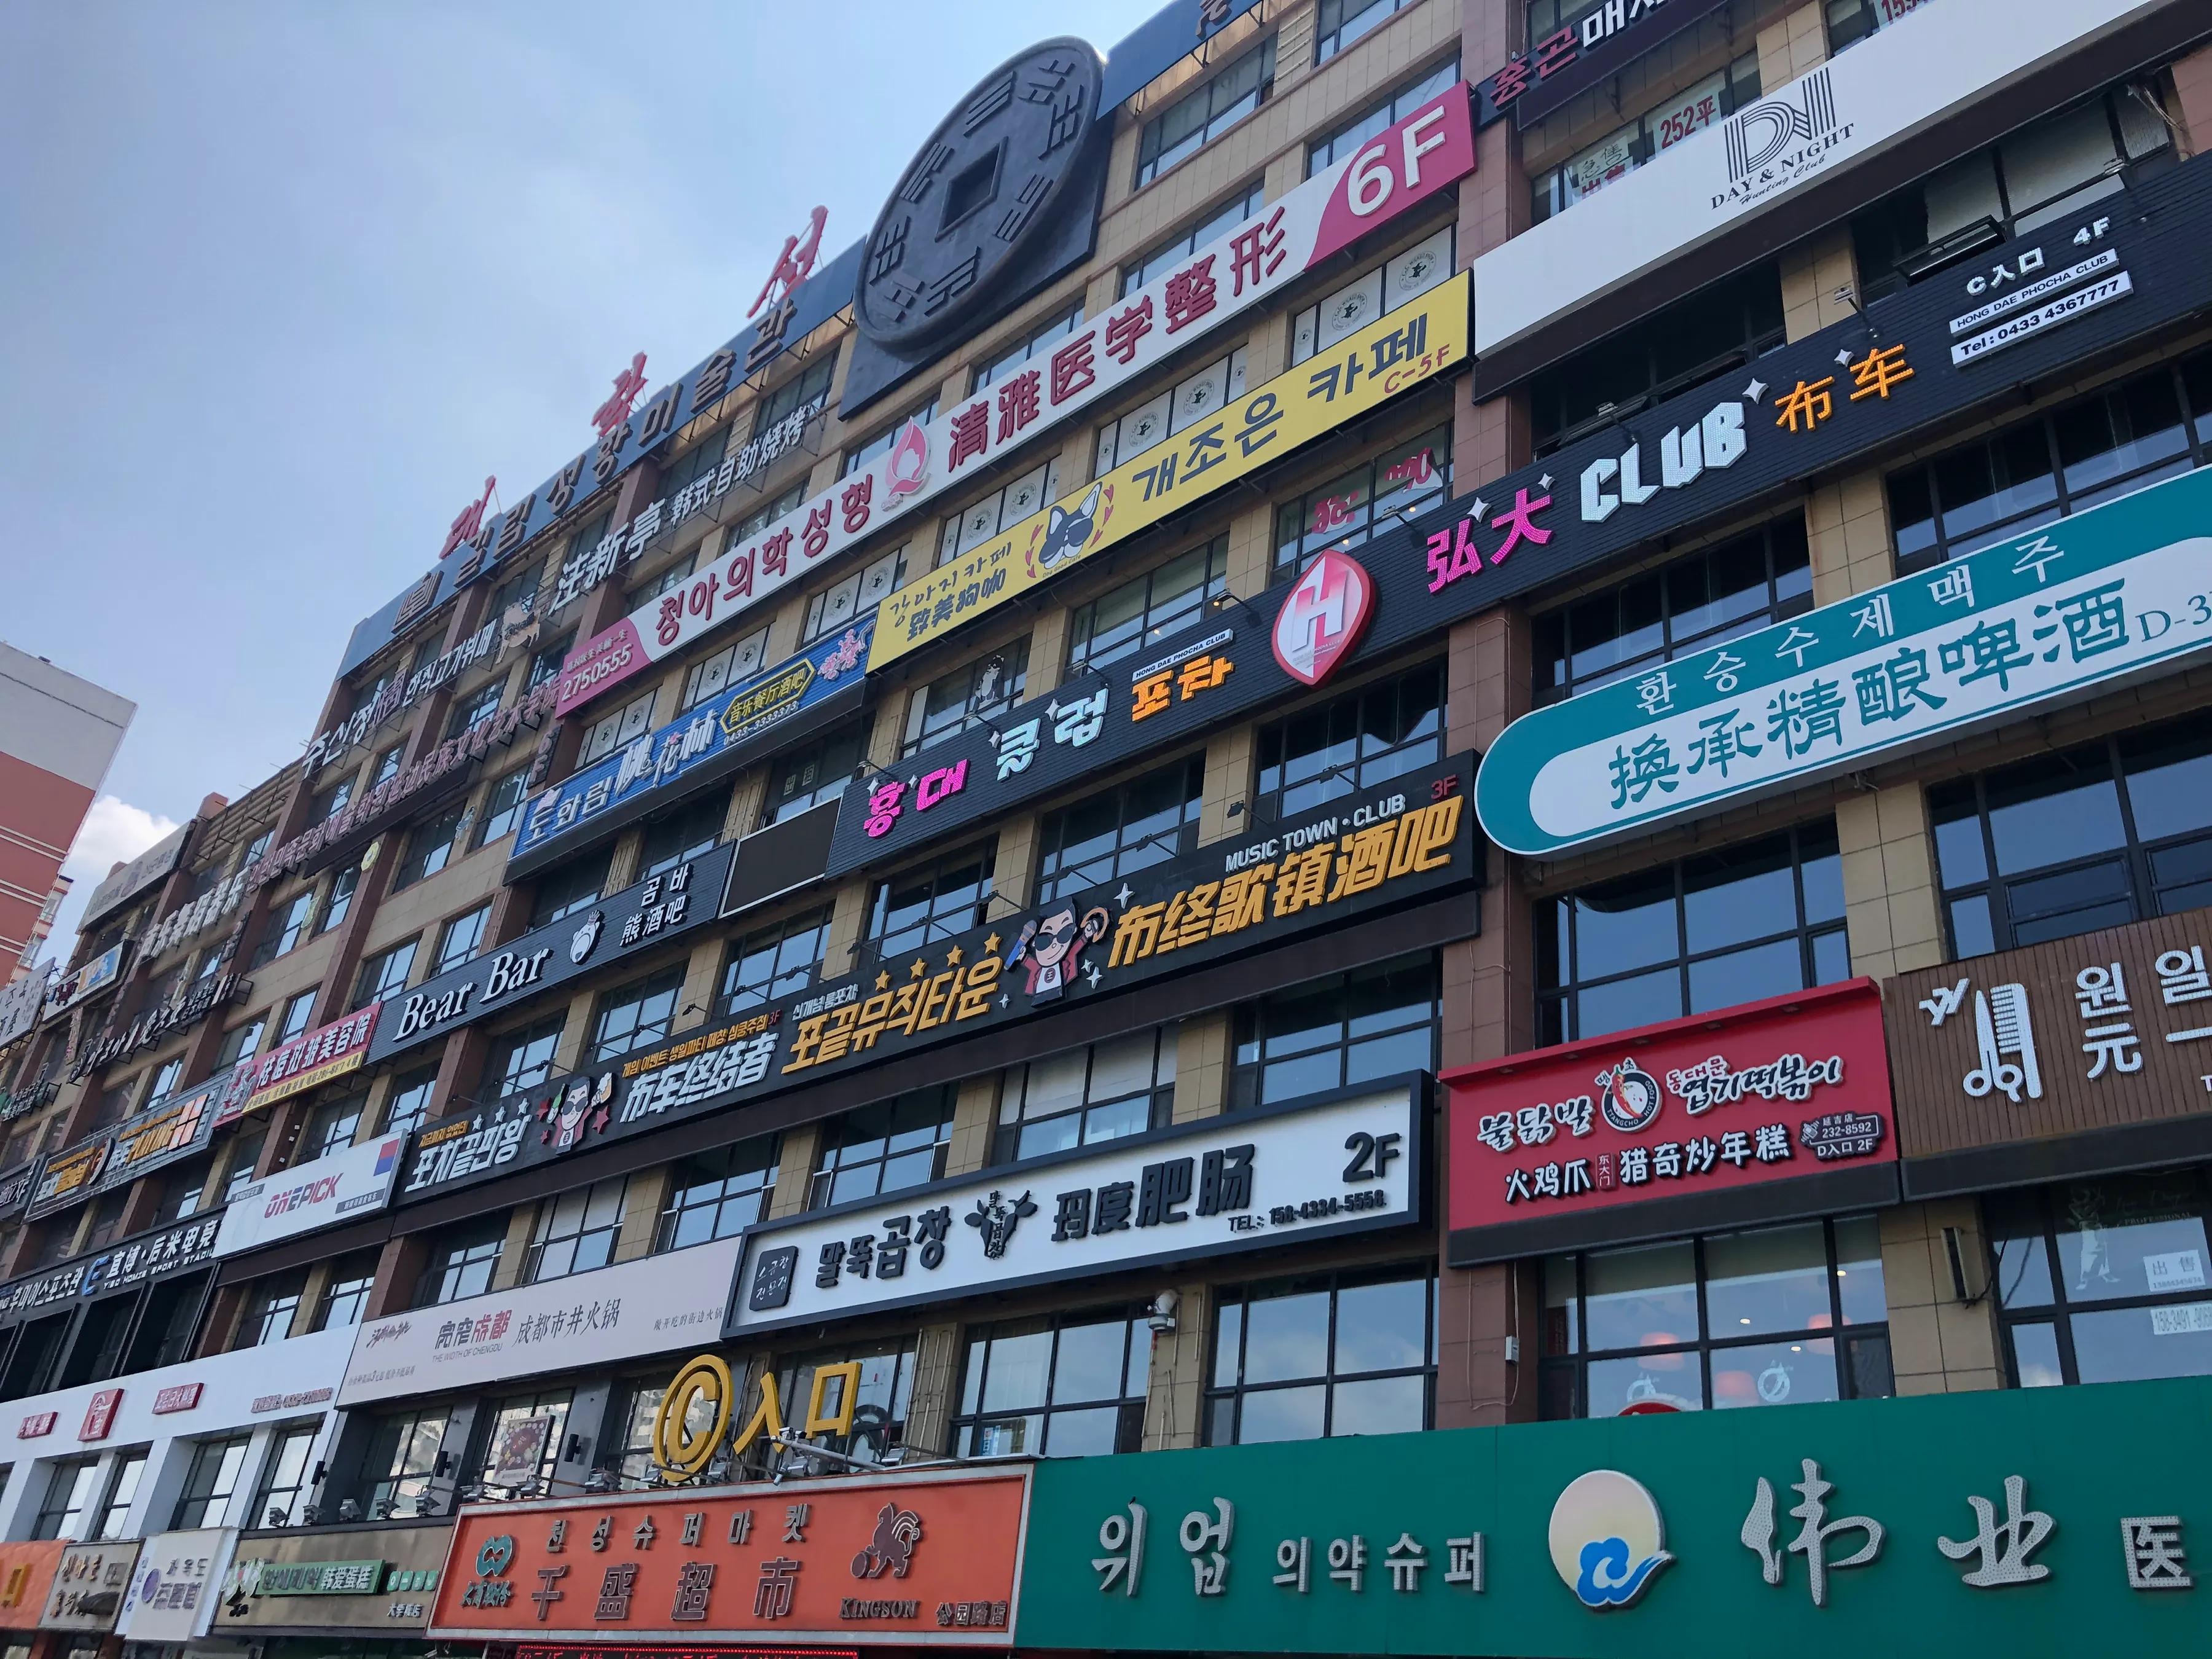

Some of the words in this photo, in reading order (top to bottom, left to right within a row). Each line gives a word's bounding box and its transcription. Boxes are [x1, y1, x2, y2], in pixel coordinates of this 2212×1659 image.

[1660, 95, 1716, 150] 252平
[1347, 104, 1446, 217] 6F
[1711, 176, 1754, 210] DAY
[1760, 168, 1775, 184] &
[1780, 123, 1854, 173] NIGHT
[1739, 176, 1789, 205] Hunting
[1794, 154, 1826, 178] Club
[2073, 216, 2109, 246] 4F
[1957, 308, 1990, 328] HONG
[1993, 296, 2018, 312] DAE
[2022, 272, 2071, 299] PHOCHA
[2075, 255, 2108, 276] CLUB
[1998, 315, 2040, 340] 0433
[2044, 280, 2120, 321] 4367777
[948, 206, 1285, 472] 清雅医学整形
[1384, 342, 1450, 394] C-5F
[1132, 393, 1284, 502] 개조은
[1307, 312, 1428, 402] 카페
[1427, 488, 1553, 594] 弘大
[1580, 402, 1747, 523] CLUB
[1775, 344, 1915, 433] 布车
[654, 474, 874, 646] 청아의학성형
[1634, 534, 2065, 714] 환승수제맥주
[2139, 591, 2212, 642] D-3
[562, 643, 633, 702] 2750555
[1137, 665, 1155, 678] HONG
[1158, 659, 1171, 667] DAE
[1174, 644, 1204, 661] PHOCHA
[1206, 633, 1225, 646] CLUB
[730, 668, 807, 724] 音乐餐厅酒吧
[615, 708, 718, 798] 桃花林
[524, 775, 613, 847] 도화림
[863, 758, 971, 839] 홍대
[1430, 774, 1459, 799] 3F
[1226, 838, 1279, 873] MUSIC
[1282, 817, 1338, 852] TOWN
[1353, 794, 1405, 828] CLUB
[619, 895, 688, 947] 熊酒吧
[392, 980, 475, 1042] Bear
[479, 947, 552, 1004] Bar
[1669, 1058, 1724, 1092] 동대문
[1682, 1056, 1841, 1111] 엽기떡볶이
[1478, 1099, 1592, 1150] 불닭발
[1817, 1143, 1853, 1157] D入口
[1857, 1139, 1875, 1152] 2F
[1822, 1122, 1872, 1139] 232-8592
[1343, 1132, 1400, 1182] 2F
[1598, 1155, 1610, 1186] 东大门
[1620, 1124, 1790, 1185] 猎奇炒年糕
[264, 1172, 344, 1219] ONEPICK
[815, 1206, 951, 1289] 말뚝곱창
[472, 1343, 503, 1357] CHENGDU
[512, 1298, 621, 1347] 成都市井火锅
[1091, 1497, 1236, 1598] 위업
[1273, 1531, 1487, 1593] 의약슈퍼
[530, 1557, 802, 1622] 千盛超市
[840, 1598, 917, 1620] KINGSON
